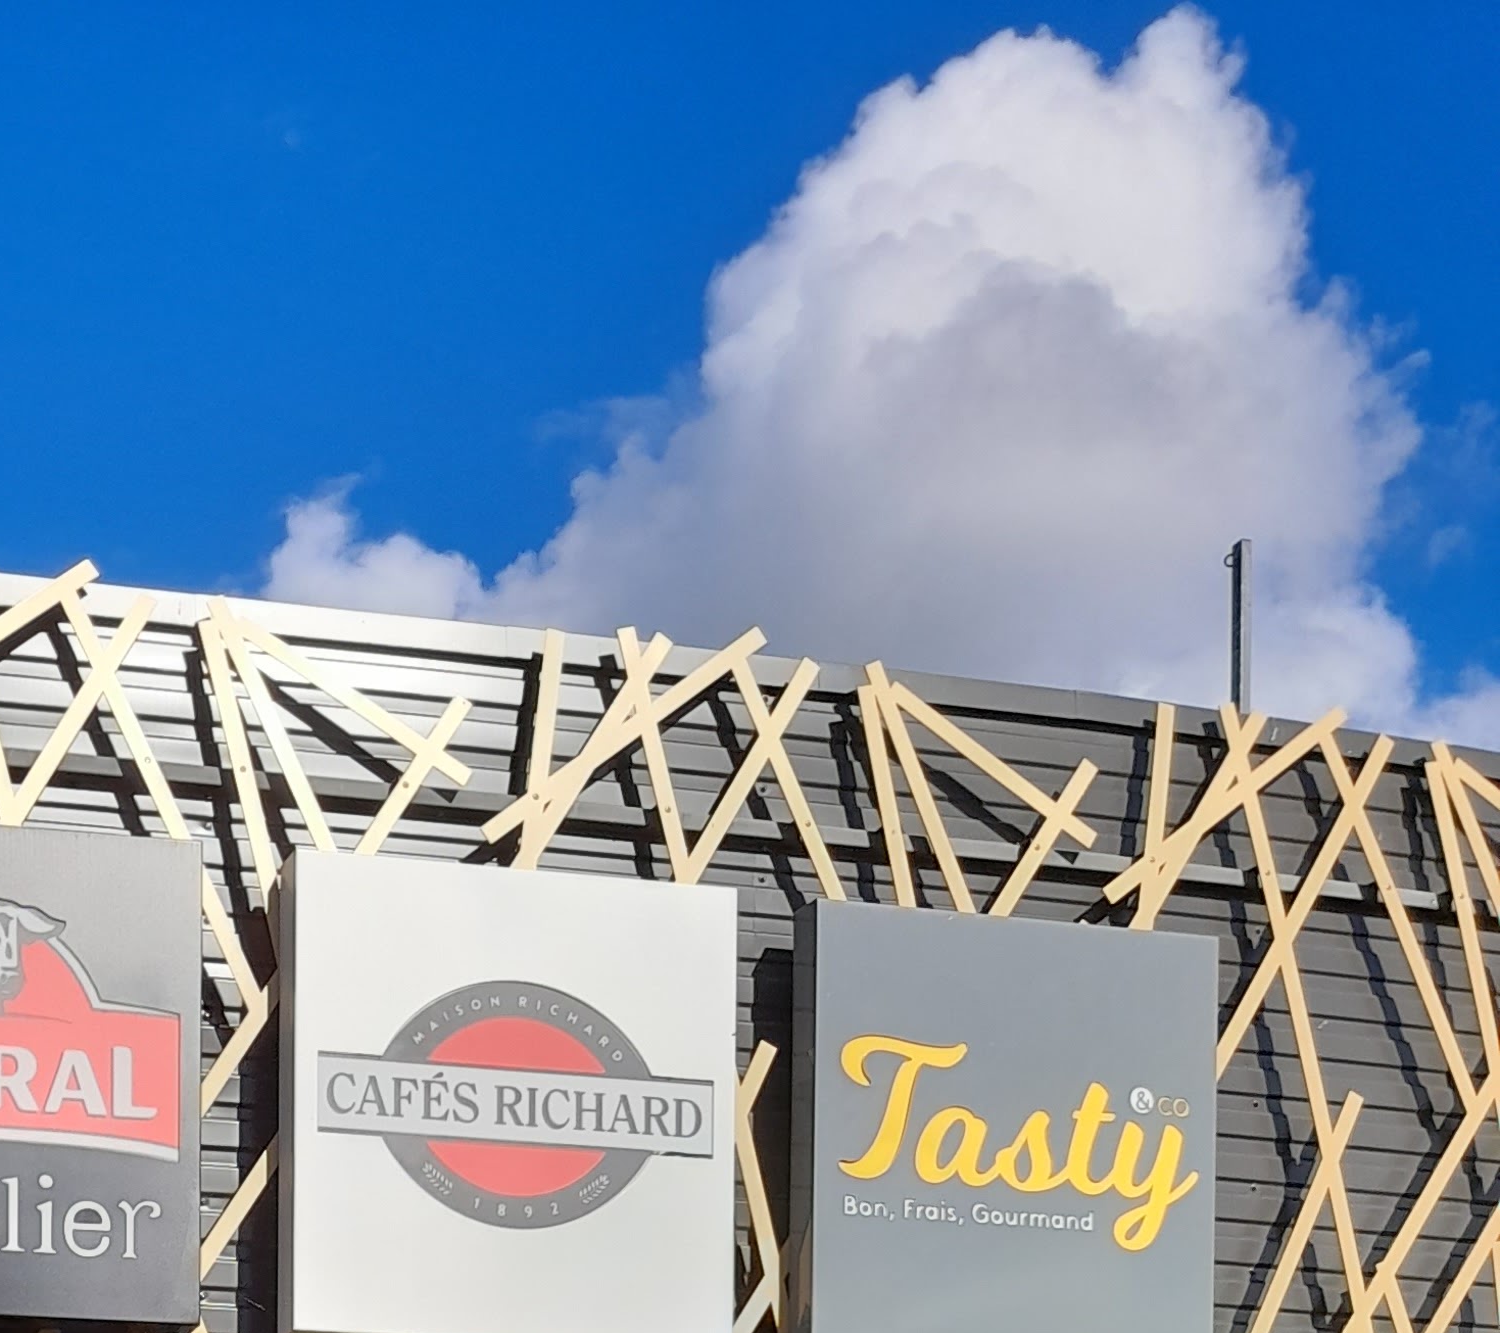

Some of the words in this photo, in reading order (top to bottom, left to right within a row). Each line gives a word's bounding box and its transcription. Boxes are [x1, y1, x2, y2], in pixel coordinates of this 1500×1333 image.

[412, 995, 501, 1046] MAISON
[518, 995, 624, 1063] RICHARD
[325, 1071, 480, 1124] CAFÉS
[493, 1084, 703, 1139] RICHARD
[838, 1033, 1200, 1252] Tasty
[472, 1196, 560, 1219] 1892
[842, 1194, 896, 1221] Bon,
[902, 1199, 965, 1226] Frais,
[971, 1203, 1095, 1232] Gourmand
